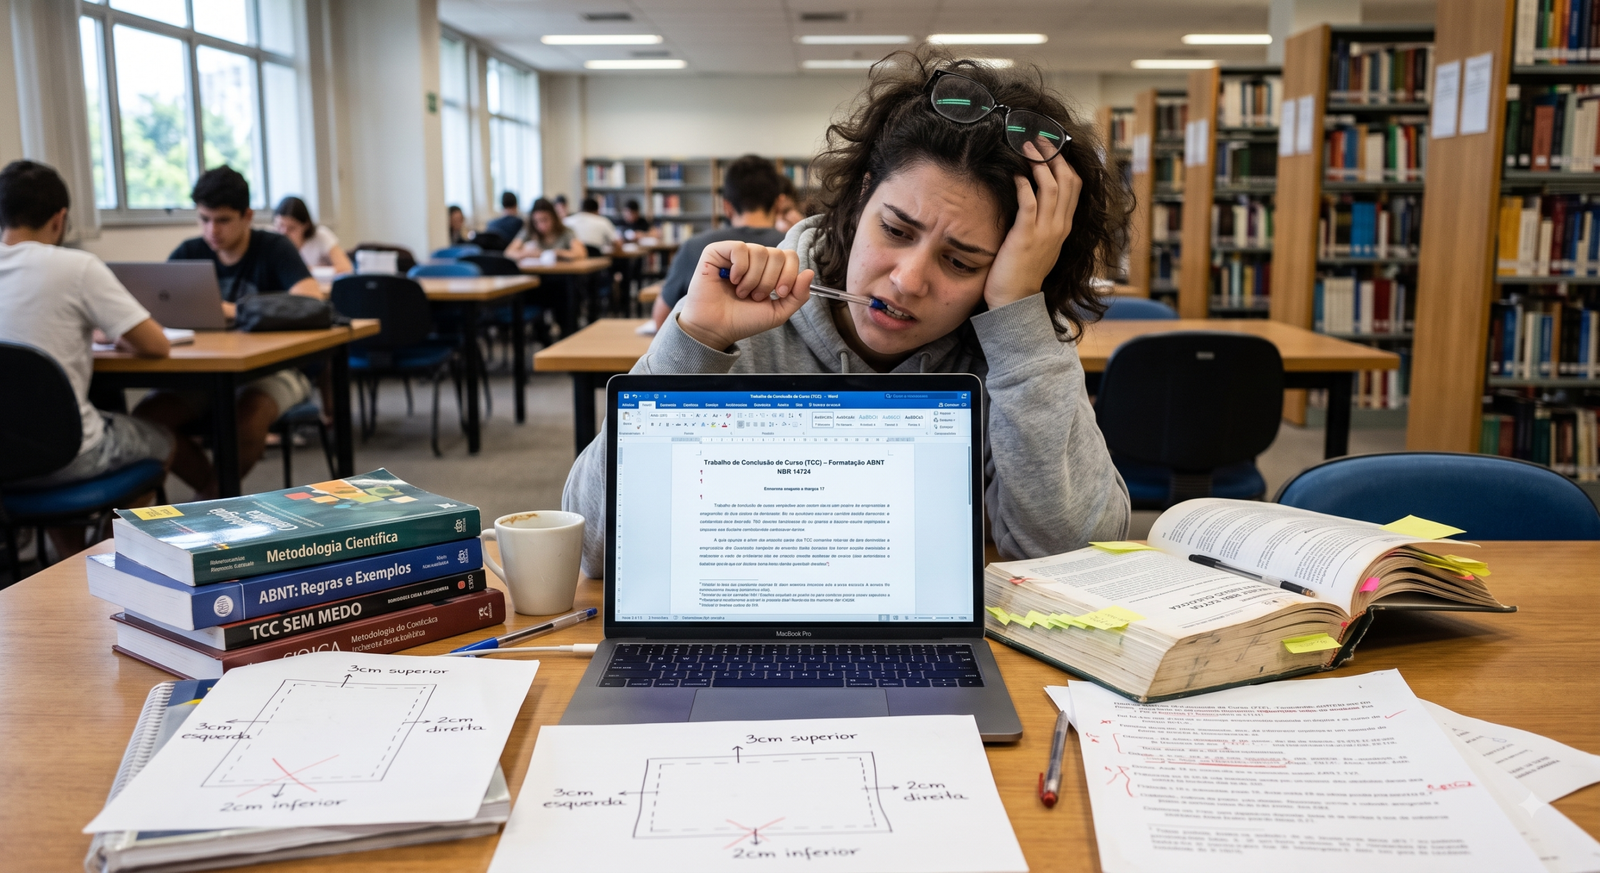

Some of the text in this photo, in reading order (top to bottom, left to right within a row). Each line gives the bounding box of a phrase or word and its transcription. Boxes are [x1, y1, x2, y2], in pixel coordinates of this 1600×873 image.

[804, 459, 823, 467] (TCC)
[828, 459, 866, 467] Formatação
[266, 532, 399, 564] Metodologia Científica
[259, 562, 412, 605] ABNT: Regras e Exemplos
[250, 602, 362, 641] TCC SEM MEDO
[351, 624, 395, 644] Metodologia
[396, 620, 405, 632] do
[347, 664, 448, 676] 3cm superior
[438, 716, 474, 724] 2cm
[196, 721, 233, 732] 3cm
[426, 723, 485, 734] direita
[181, 732, 252, 742] esquerda
[746, 732, 858, 745] 3cm superior
[907, 780, 946, 790] 2cm
[554, 788, 594, 797] 3cm
[903, 790, 965, 801] direita
[219, 799, 343, 812] 2cm inferior
[542, 798, 627, 810] esquerda
[732, 845, 859, 861] 2cm inferior
